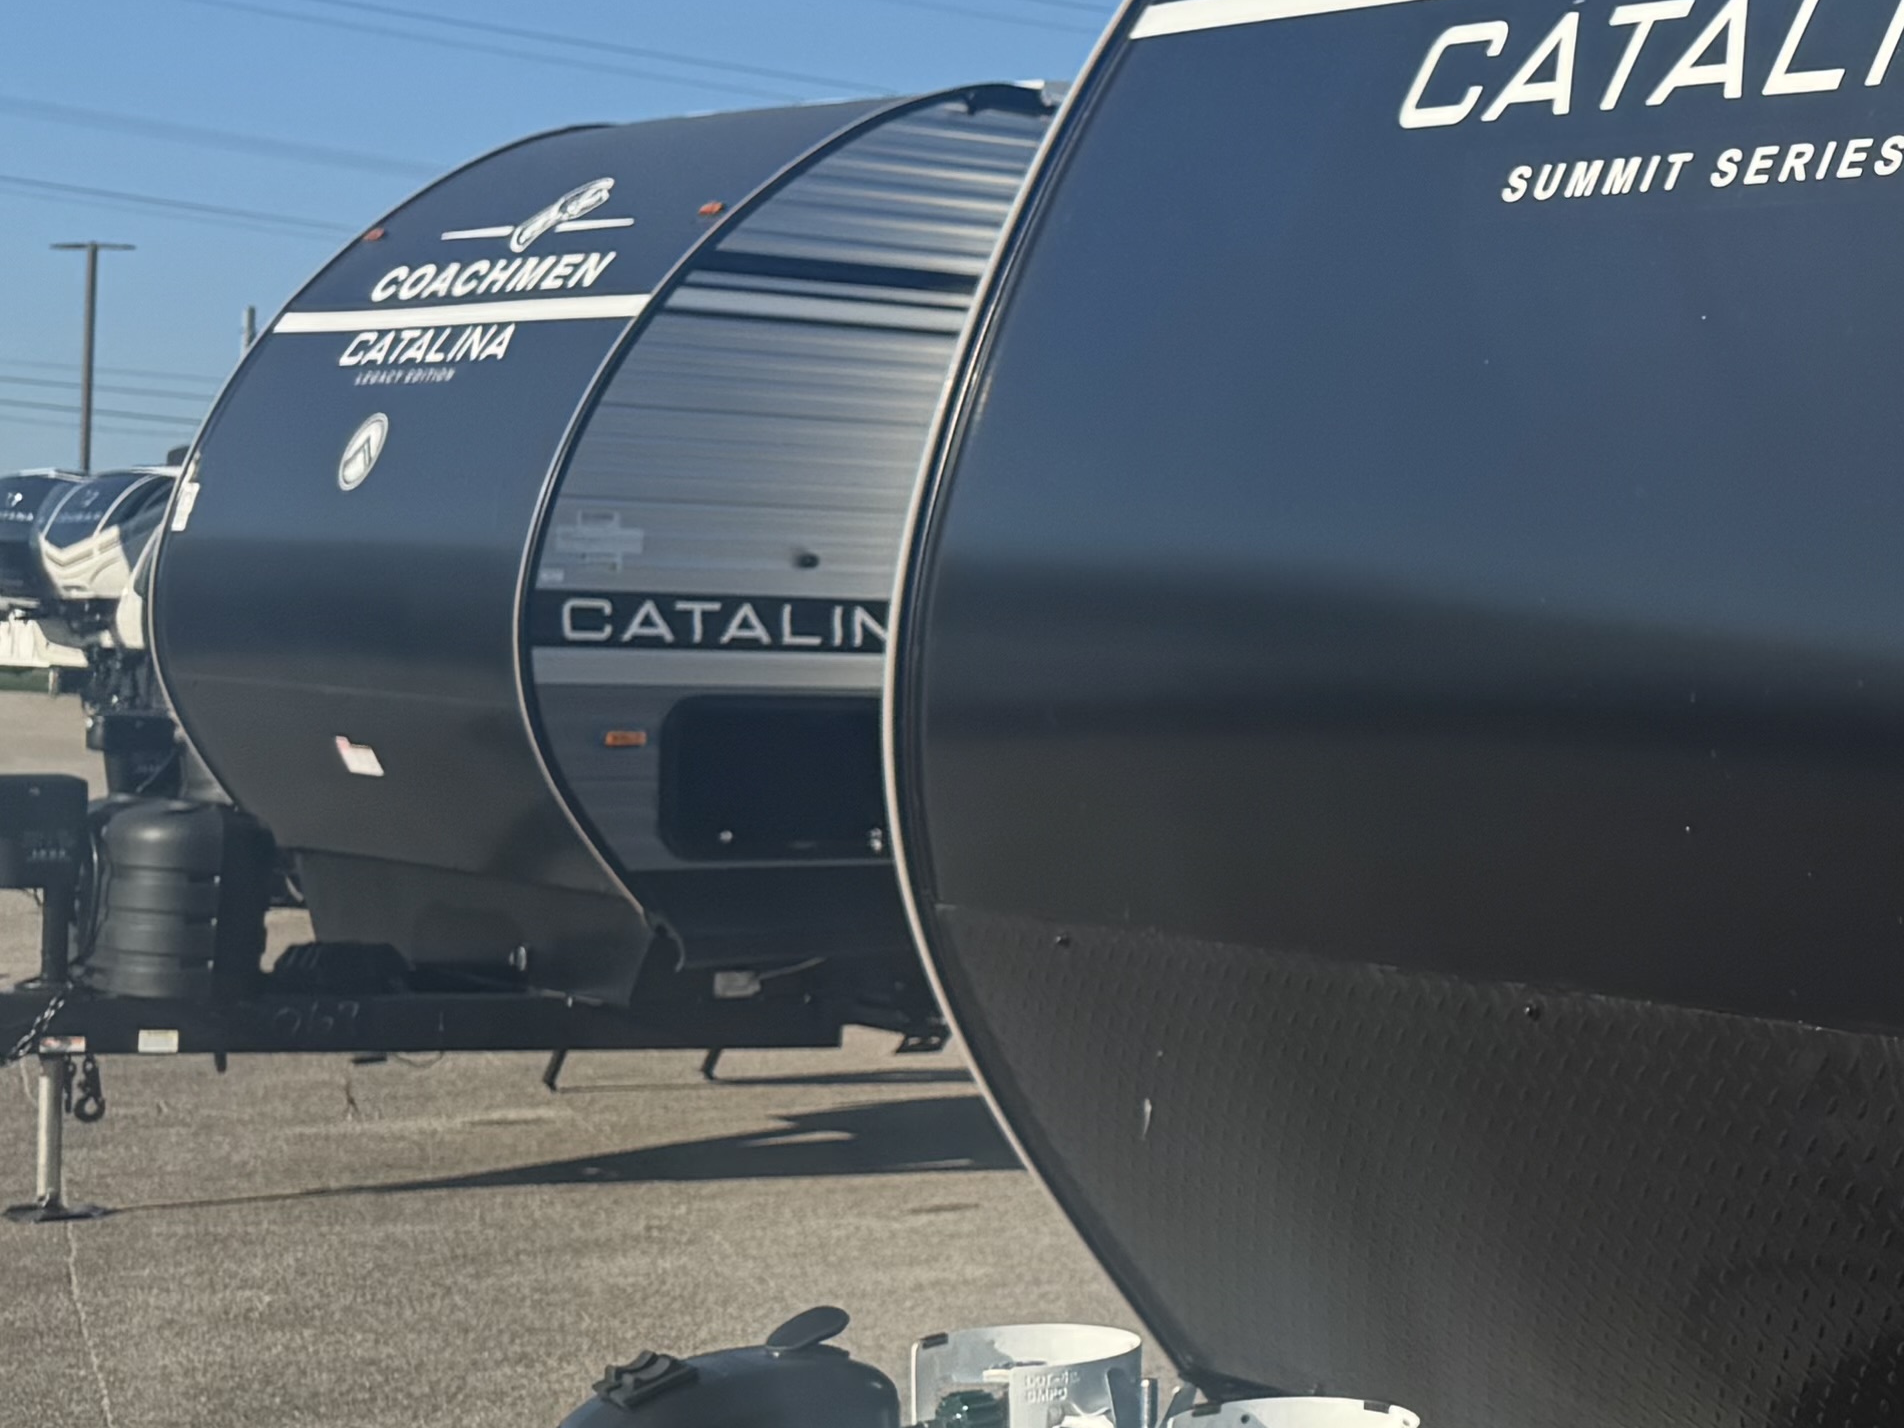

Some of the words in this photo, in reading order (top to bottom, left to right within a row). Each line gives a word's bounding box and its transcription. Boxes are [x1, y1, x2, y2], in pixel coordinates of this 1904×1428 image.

[1501, 152, 1694, 203] SUMMIT
[371, 251, 617, 302] COACHMEN
[338, 323, 516, 367] CATALINA
[353, 369, 404, 386] LEGACY
[403, 367, 456, 384] EDITION
[561, 597, 890, 648] CATALIN
